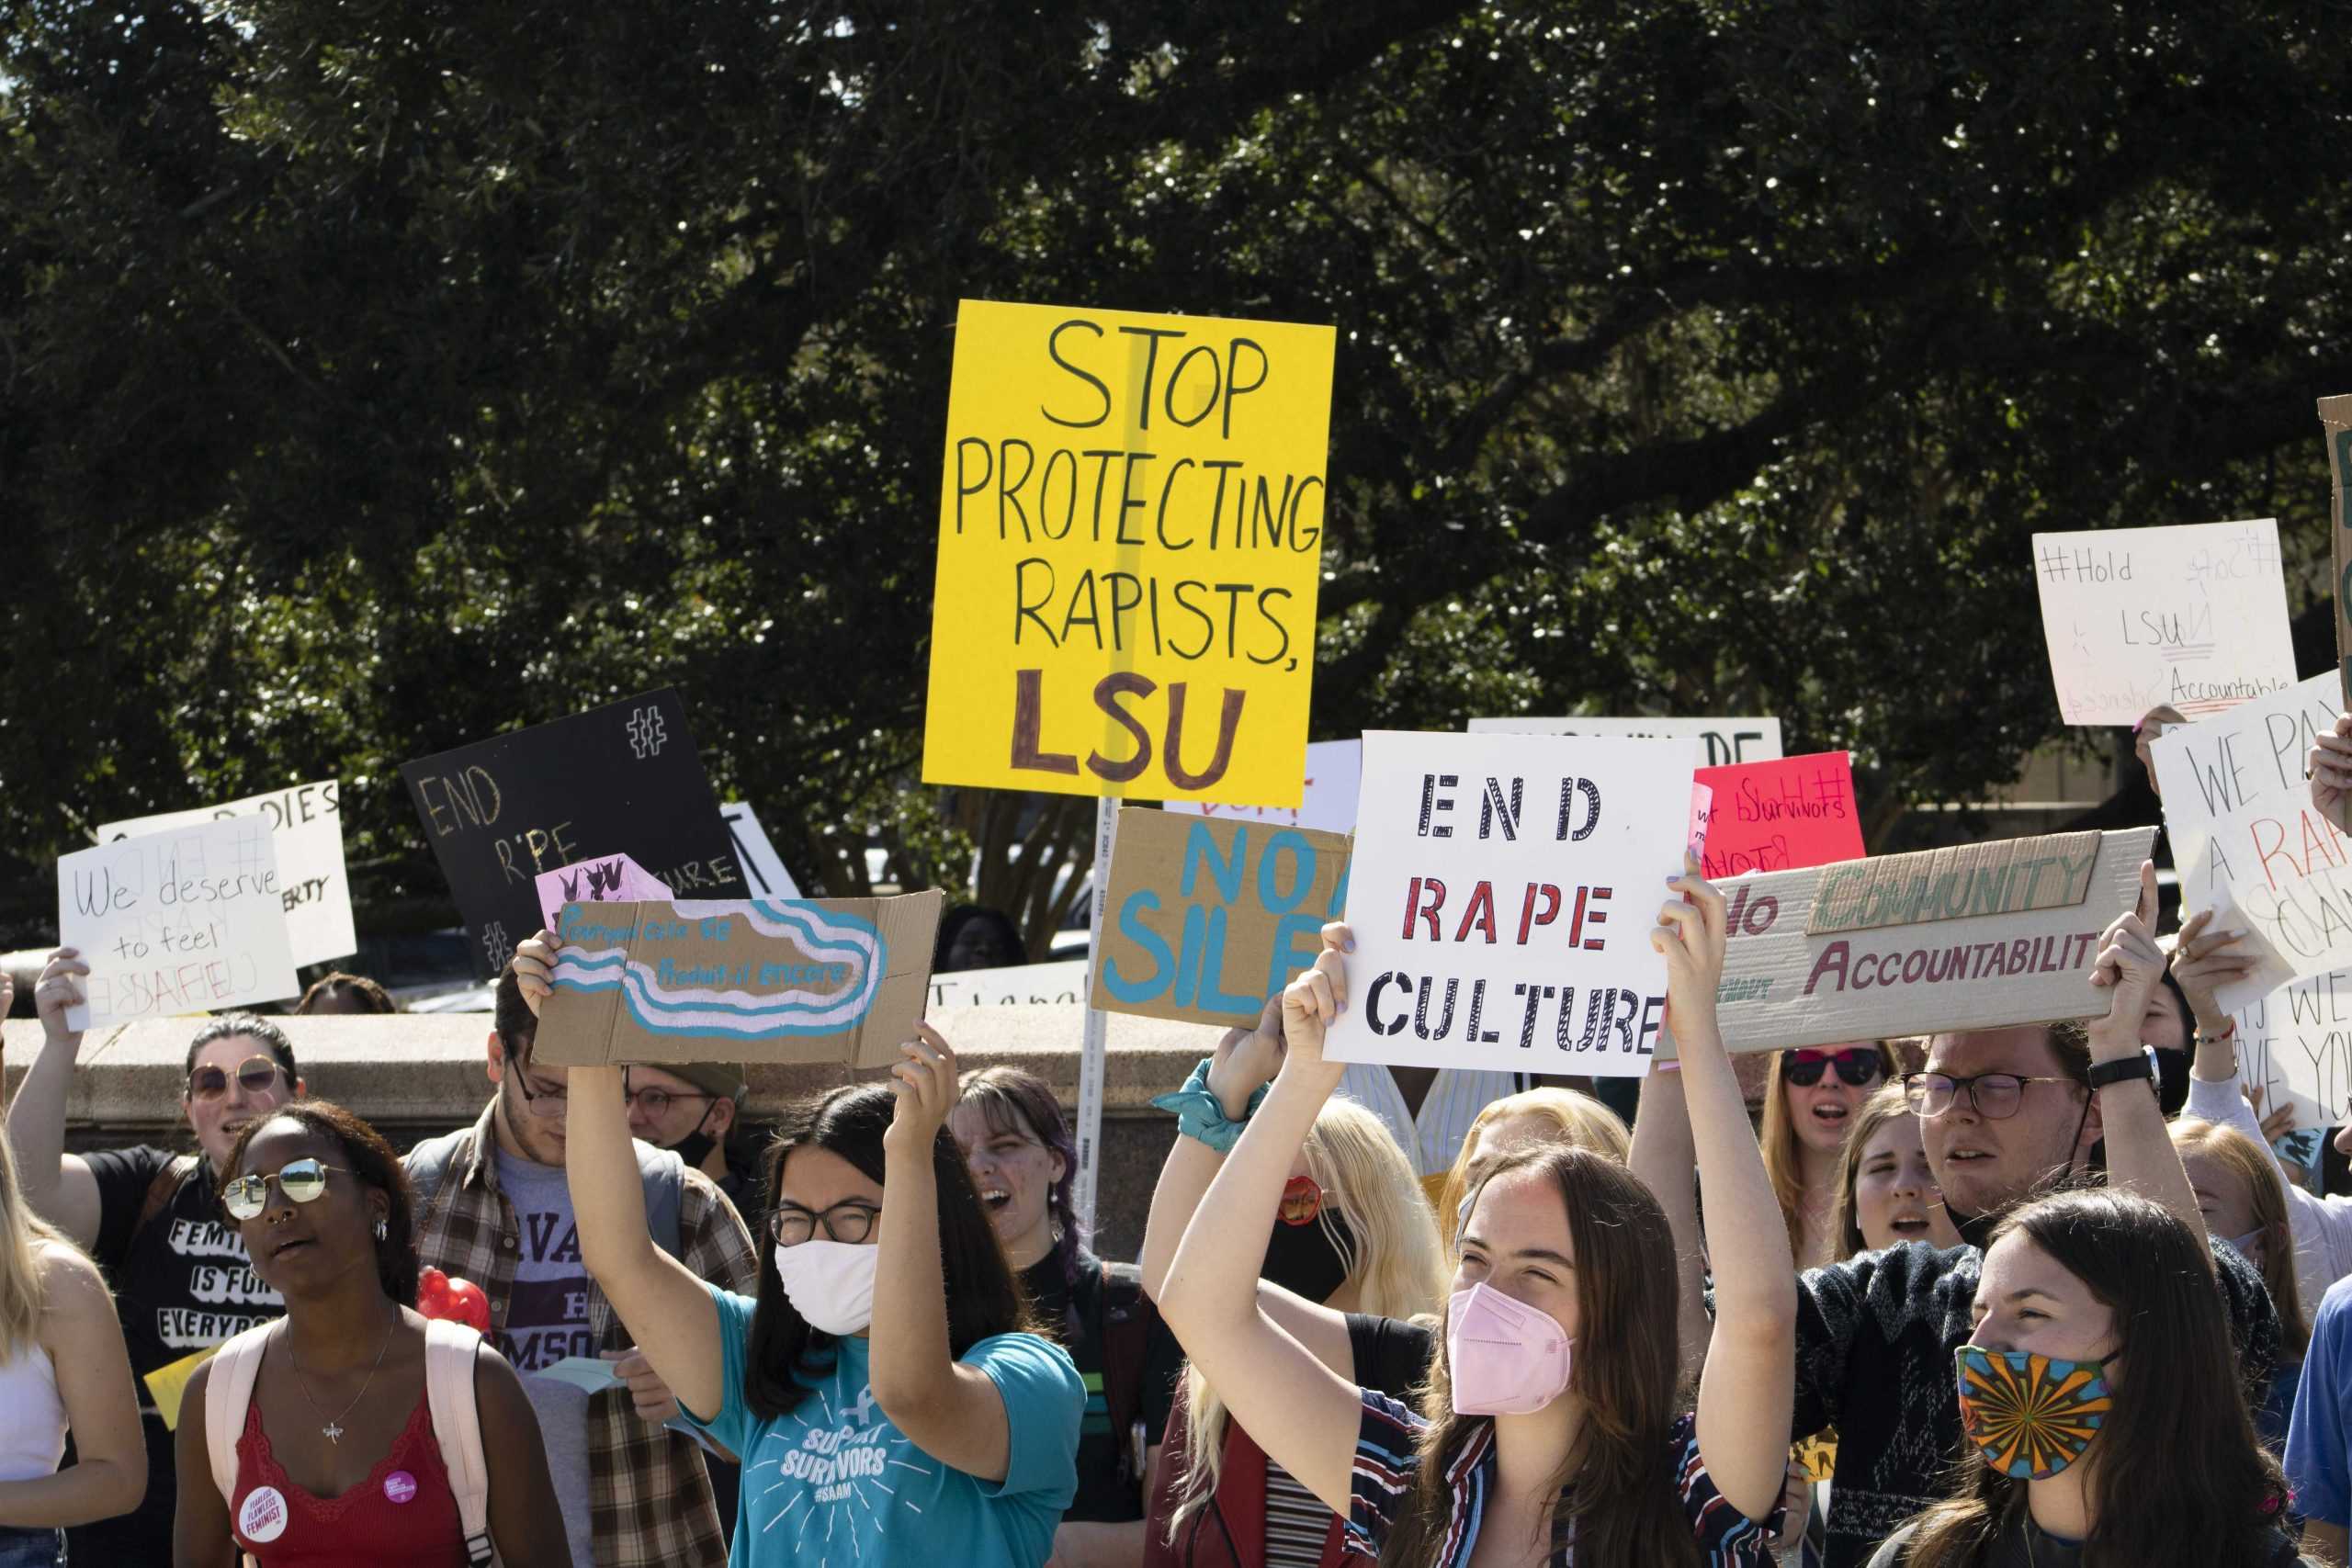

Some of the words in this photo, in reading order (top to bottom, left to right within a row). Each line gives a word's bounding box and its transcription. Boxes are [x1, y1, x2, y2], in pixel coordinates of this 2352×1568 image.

[1041, 319, 1269, 440] STOP
[956, 436, 1325, 553] PROTECTING
[2041, 544, 2132, 583] #Hold
[1013, 557, 1299, 672] RAPISTS,
[2121, 609, 2185, 647] LSU
[1011, 668, 1248, 791] LSU
[418, 765, 502, 837] END
[1741, 777, 1846, 822] Survivors
[2185, 731, 2259, 817] WE
[1418, 773, 1601, 841] END
[74, 865, 138, 917] We
[160, 859, 281, 906] deserve
[1179, 820, 1317, 916] NO
[1815, 853, 2092, 928] COMMUNITY
[2210, 835, 2235, 891] A
[113, 935, 150, 961] to
[162, 922, 219, 953] feel
[1402, 876, 1613, 951] RAPE
[124, 961, 236, 1015] SAFE
[1803, 931, 2104, 996] ACCOUNTABILIT
[1365, 970, 1666, 1055] CULTURE
[169, 1219, 246, 1255] FEMI
[191, 1267, 217, 1292] IS
[159, 1309, 276, 1338] EVERYB
[245, 1506, 280, 1536] FEMINIST
[814, 1482, 852, 1503] #SAAM
